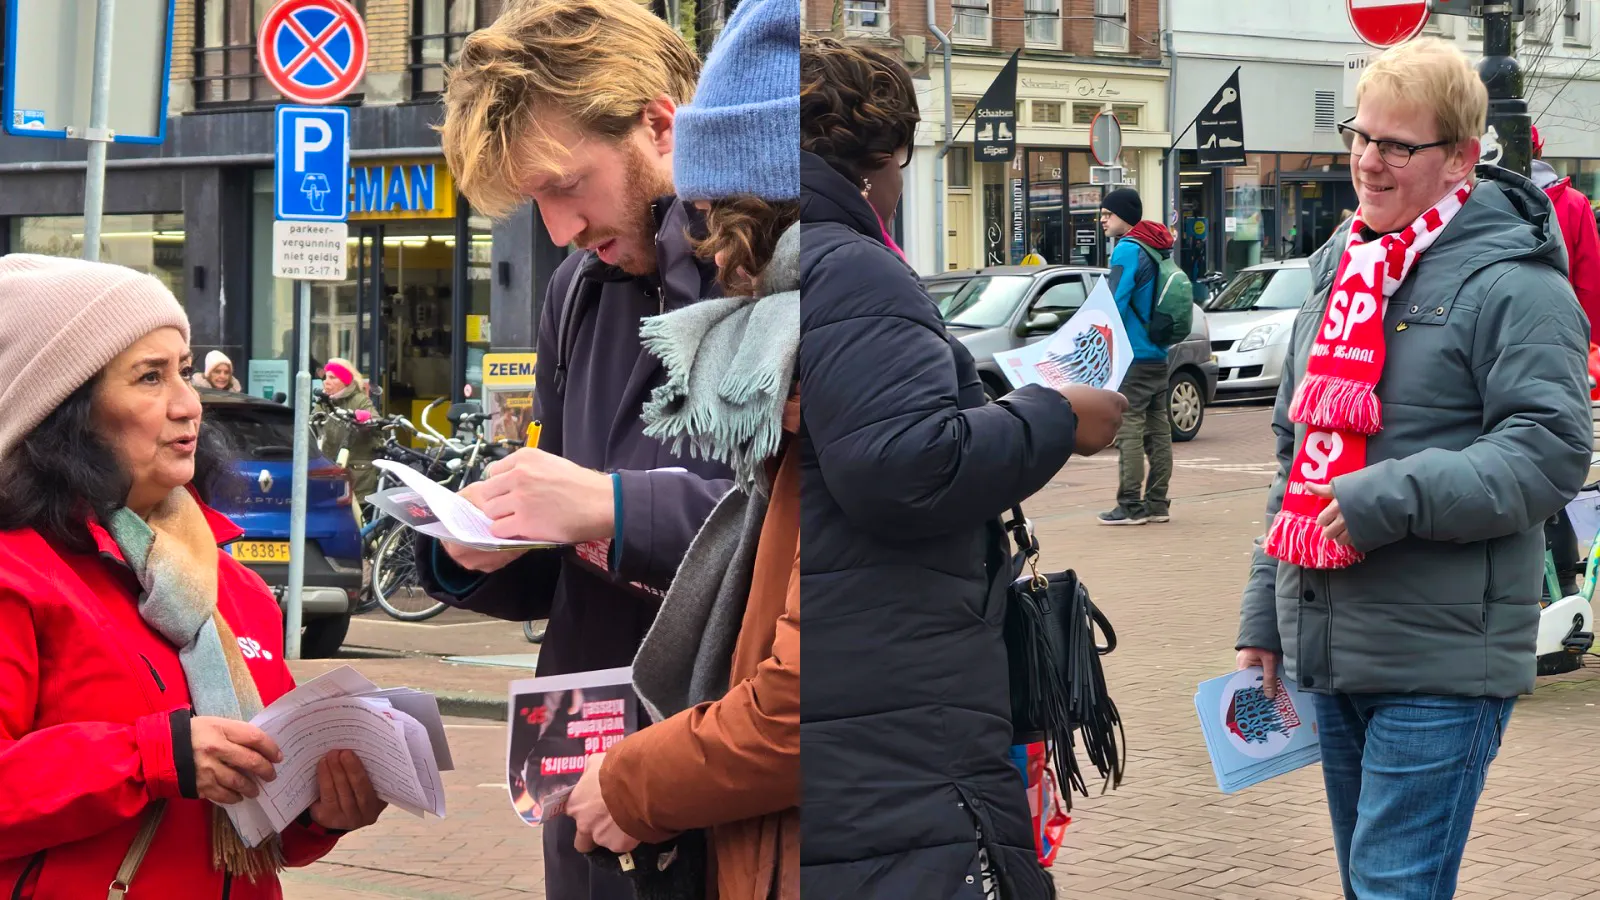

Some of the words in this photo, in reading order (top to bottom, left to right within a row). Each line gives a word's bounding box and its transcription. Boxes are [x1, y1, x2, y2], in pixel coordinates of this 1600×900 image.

[1348, 57, 1368, 69] uit
[294, 117, 332, 172] P
[289, 224, 335, 235] parkeer-
[281, 238, 341, 251] vergunning
[283, 252, 305, 261] niet
[307, 251, 339, 264] geldig
[281, 266, 300, 275] van
[303, 265, 330, 275] 12-17
[334, 266, 340, 276] h
[1324, 290, 1378, 341] SP
[236, 543, 291, 558] K-838-F
